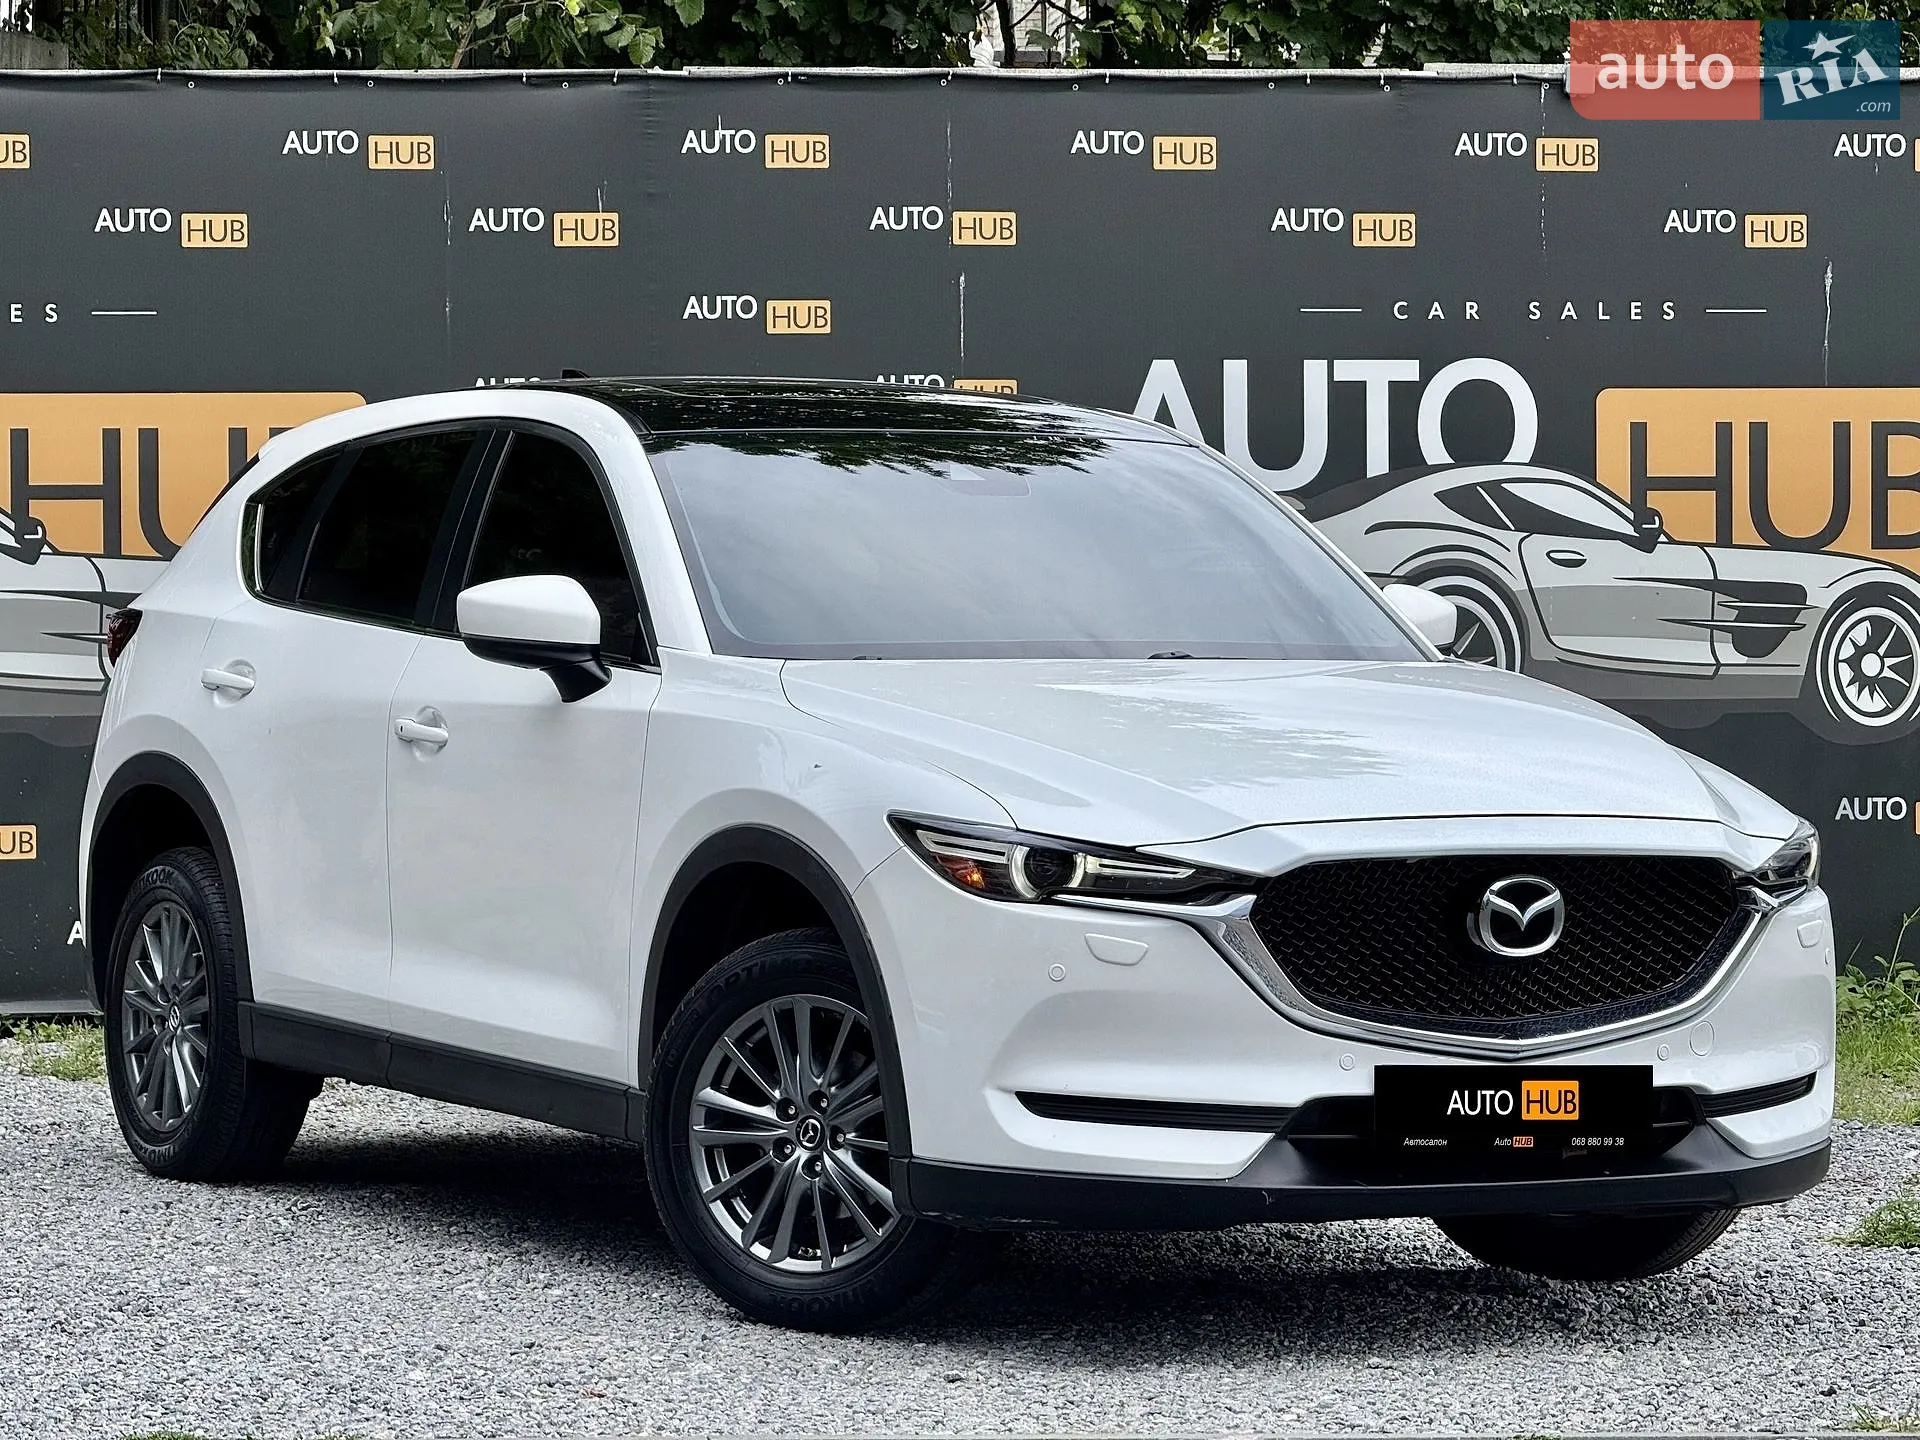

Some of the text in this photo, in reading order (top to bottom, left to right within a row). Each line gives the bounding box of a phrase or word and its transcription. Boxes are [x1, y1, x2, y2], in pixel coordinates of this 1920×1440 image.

[282, 130, 432, 165] AUTO HUB
[681, 129, 827, 164] AUTO HUB
[1071, 130, 1214, 165] AUTO HUB
[1455, 132, 1596, 167] AUTO HUB
[1834, 133, 1907, 157] AUTO
[94, 208, 245, 243] AUTO HUB
[469, 207, 616, 242] AUTO HUB
[869, 206, 1014, 241] AUTO HUB
[1271, 207, 1413, 242] AUTO HUB
[1664, 209, 1805, 243] AUTO HUB
[683, 295, 828, 329] AUTO HUB
[1393, 301, 1676, 321] CAR SALES
[10, 427, 296, 561] HU
[1834, 796, 1907, 820] AUTO
